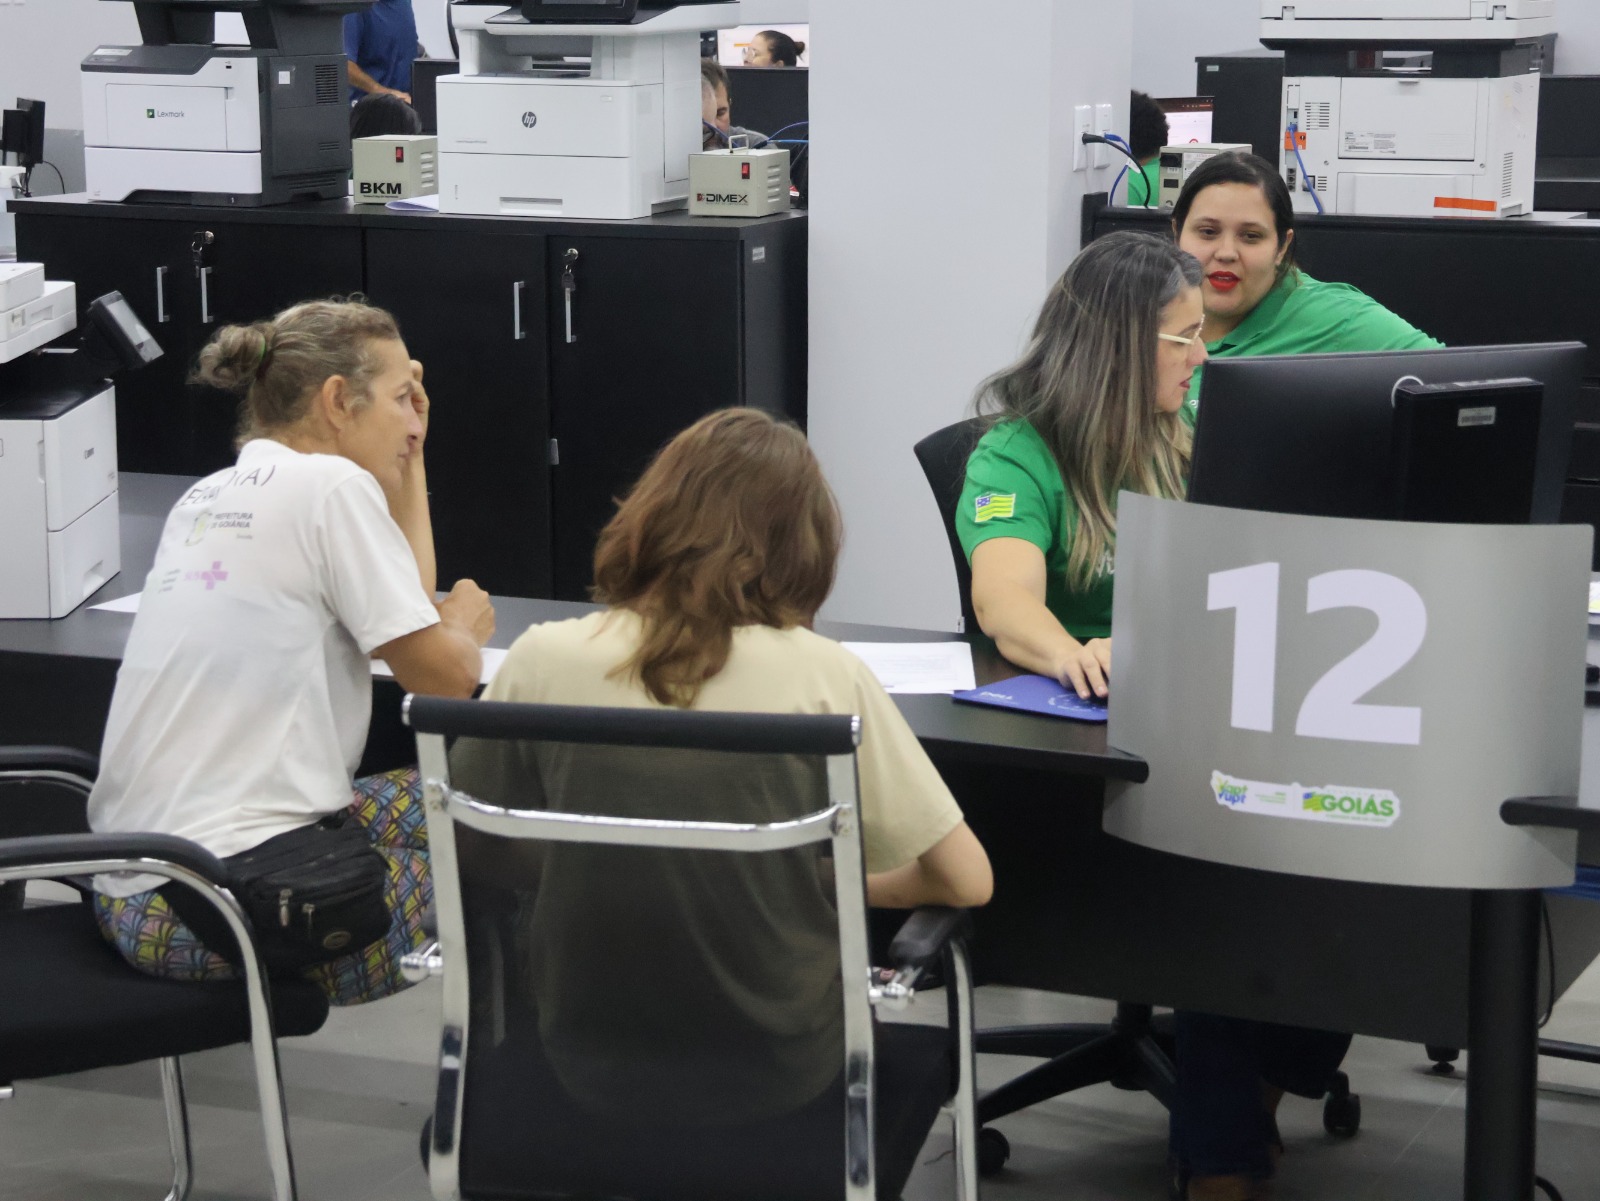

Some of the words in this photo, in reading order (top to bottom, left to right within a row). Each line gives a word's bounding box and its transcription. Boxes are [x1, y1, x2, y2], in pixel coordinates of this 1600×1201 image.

[157, 110, 185, 118] Lexmark
[360, 182, 402, 194] BKM
[706, 193, 748, 203] DIMEX
[1207, 562, 1427, 745] 12
[1321, 794, 1394, 816] GOIÁS
